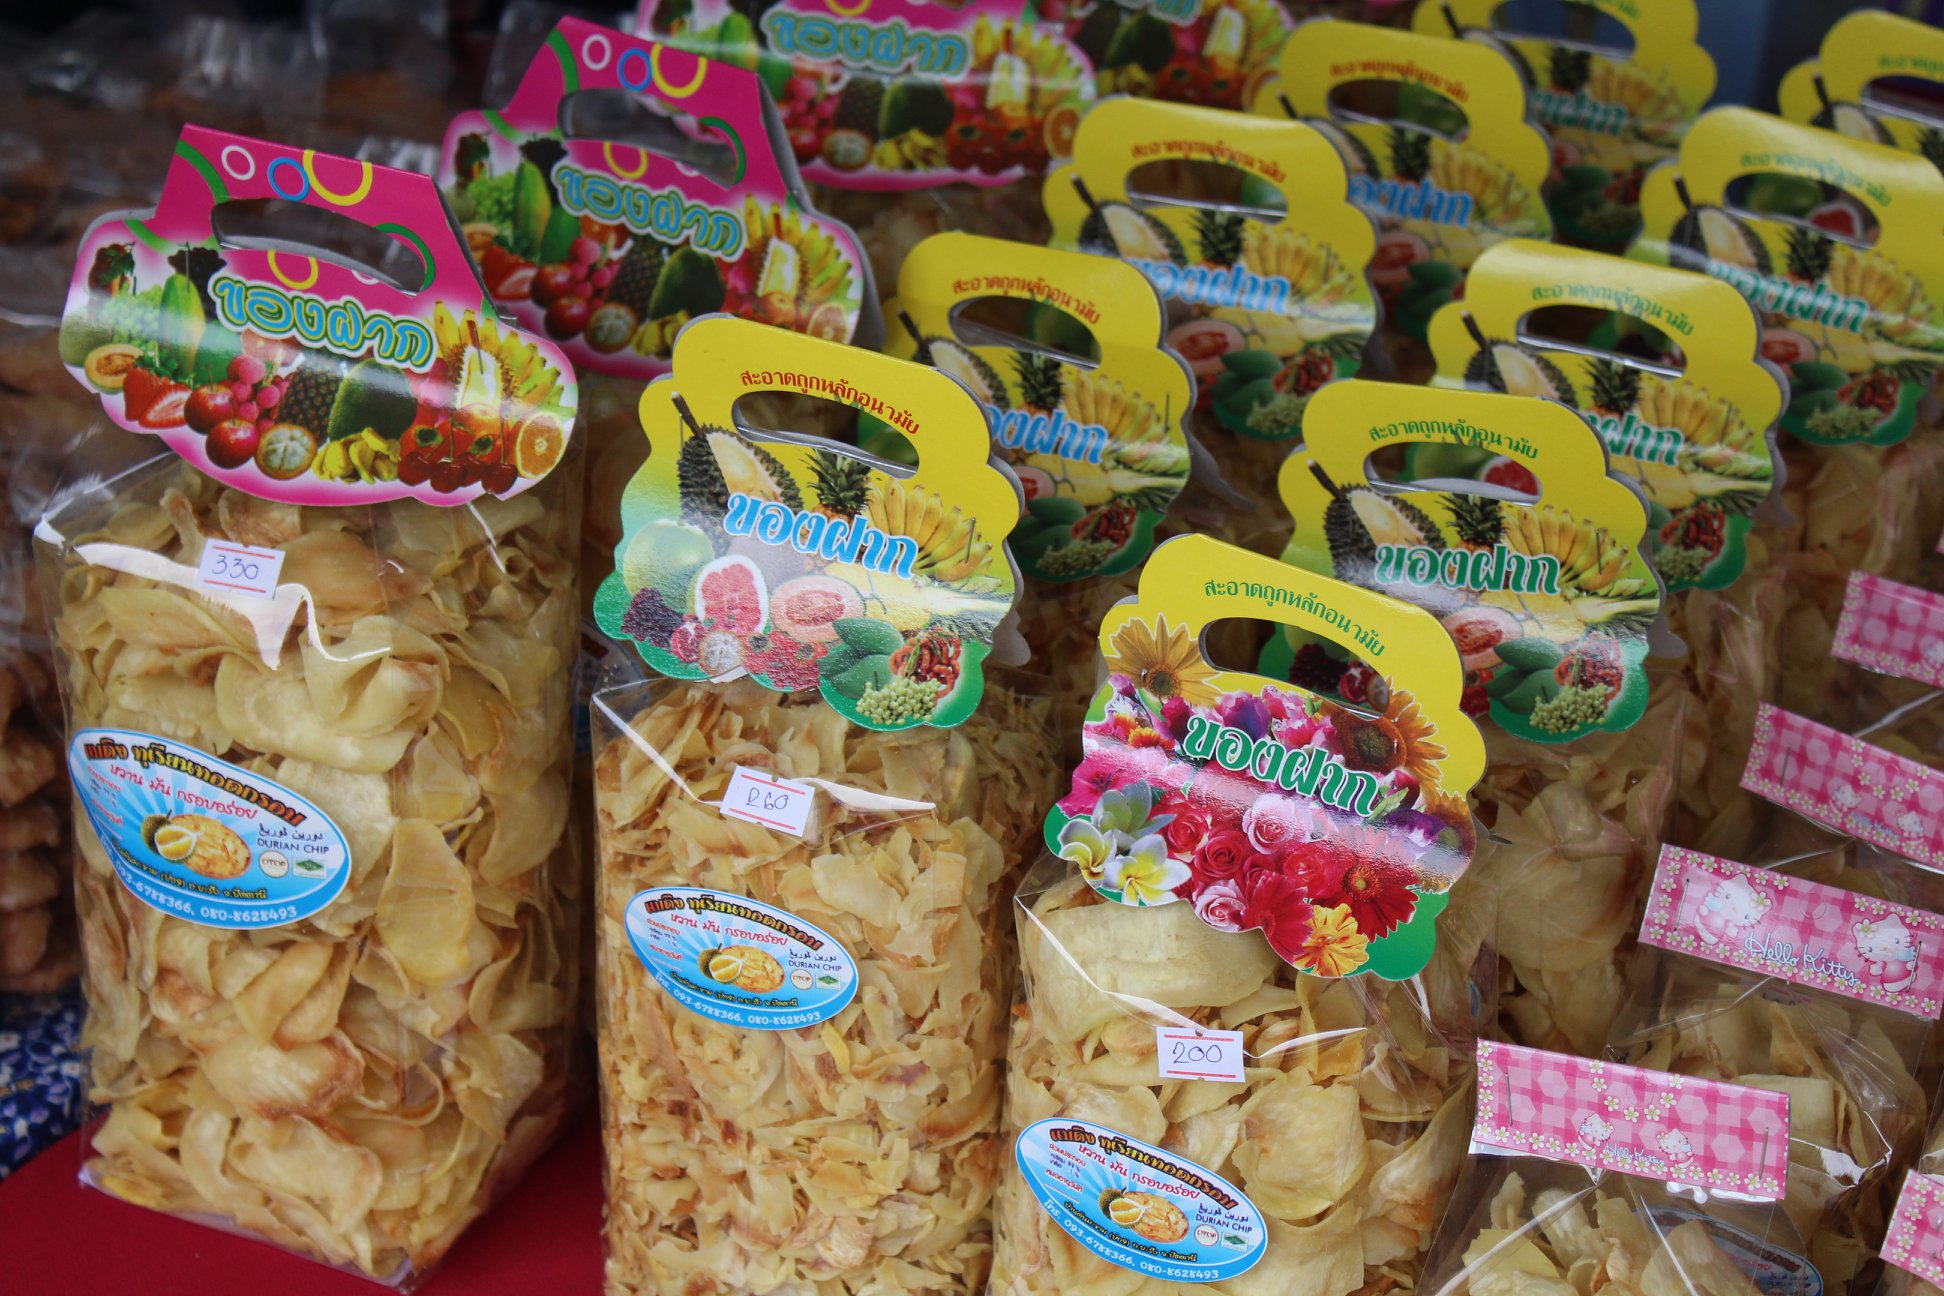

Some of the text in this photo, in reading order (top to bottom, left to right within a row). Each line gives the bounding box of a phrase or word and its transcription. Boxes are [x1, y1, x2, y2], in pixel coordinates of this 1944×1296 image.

[760, 6, 972, 82] ของฝาก
[551, 161, 746, 262] ของฝาก
[209, 272, 437, 373] ของฝาก
[740, 369, 920, 435] สะอาดถูกหลักอนามัย
[1369, 418, 1539, 459] สะอาดถูกหลักอนามัย
[724, 492, 920, 579] ของฝาก
[212, 554, 259, 580] 330
[1375, 543, 1561, 595] ของฝาก
[1204, 579, 1386, 657] สะอาดถูกหลักอนามัย
[1182, 715, 1381, 818] ของฝาก
[149, 776, 171, 796] มัน
[177, 790, 258, 820] กรอบอร่อย
[746, 787, 789, 810] 260
[257, 837, 330, 855] DURIAN CHIP
[200, 905, 298, 923] 080-8628493
[702, 919, 720, 934] มัน
[725, 927, 788, 946] กรอบอร่อย
[788, 960, 842, 972] DURIAN CHIP
[1744, 930, 1860, 988] Hello Kitty
[748, 1011, 821, 1026] 080-8628493
[1172, 1041, 1222, 1064] 200
[1109, 1160, 1128, 1178] มัน
[1131, 1173, 1201, 1200] กรอบอร่อย
[1196, 1214, 1253, 1233] DURIAN CHIP
[1140, 1260, 1219, 1279] 080-8628493
